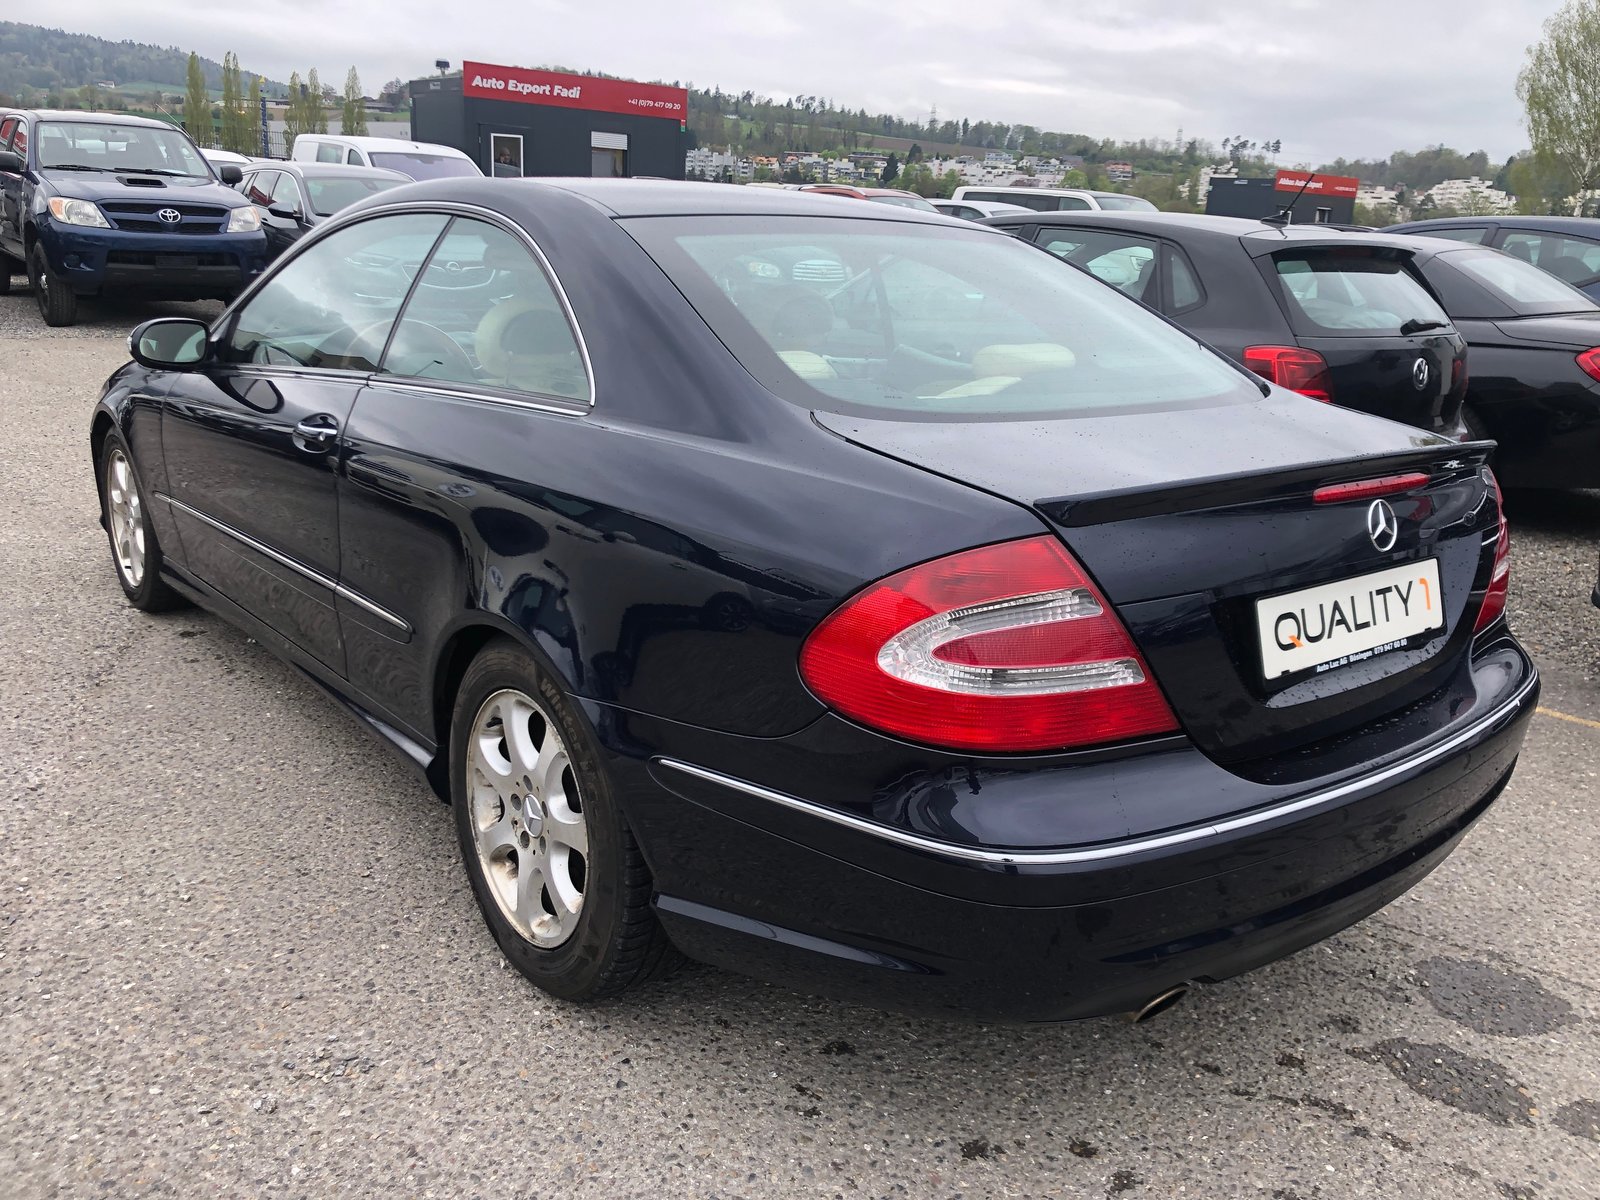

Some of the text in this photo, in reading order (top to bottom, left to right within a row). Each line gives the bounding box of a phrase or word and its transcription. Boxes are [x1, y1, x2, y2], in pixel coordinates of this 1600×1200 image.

[471, 75, 581, 99] Auto Export Fadi
[1316, 664, 1330, 673] Auto
[1340, 658, 1348, 666] AG
